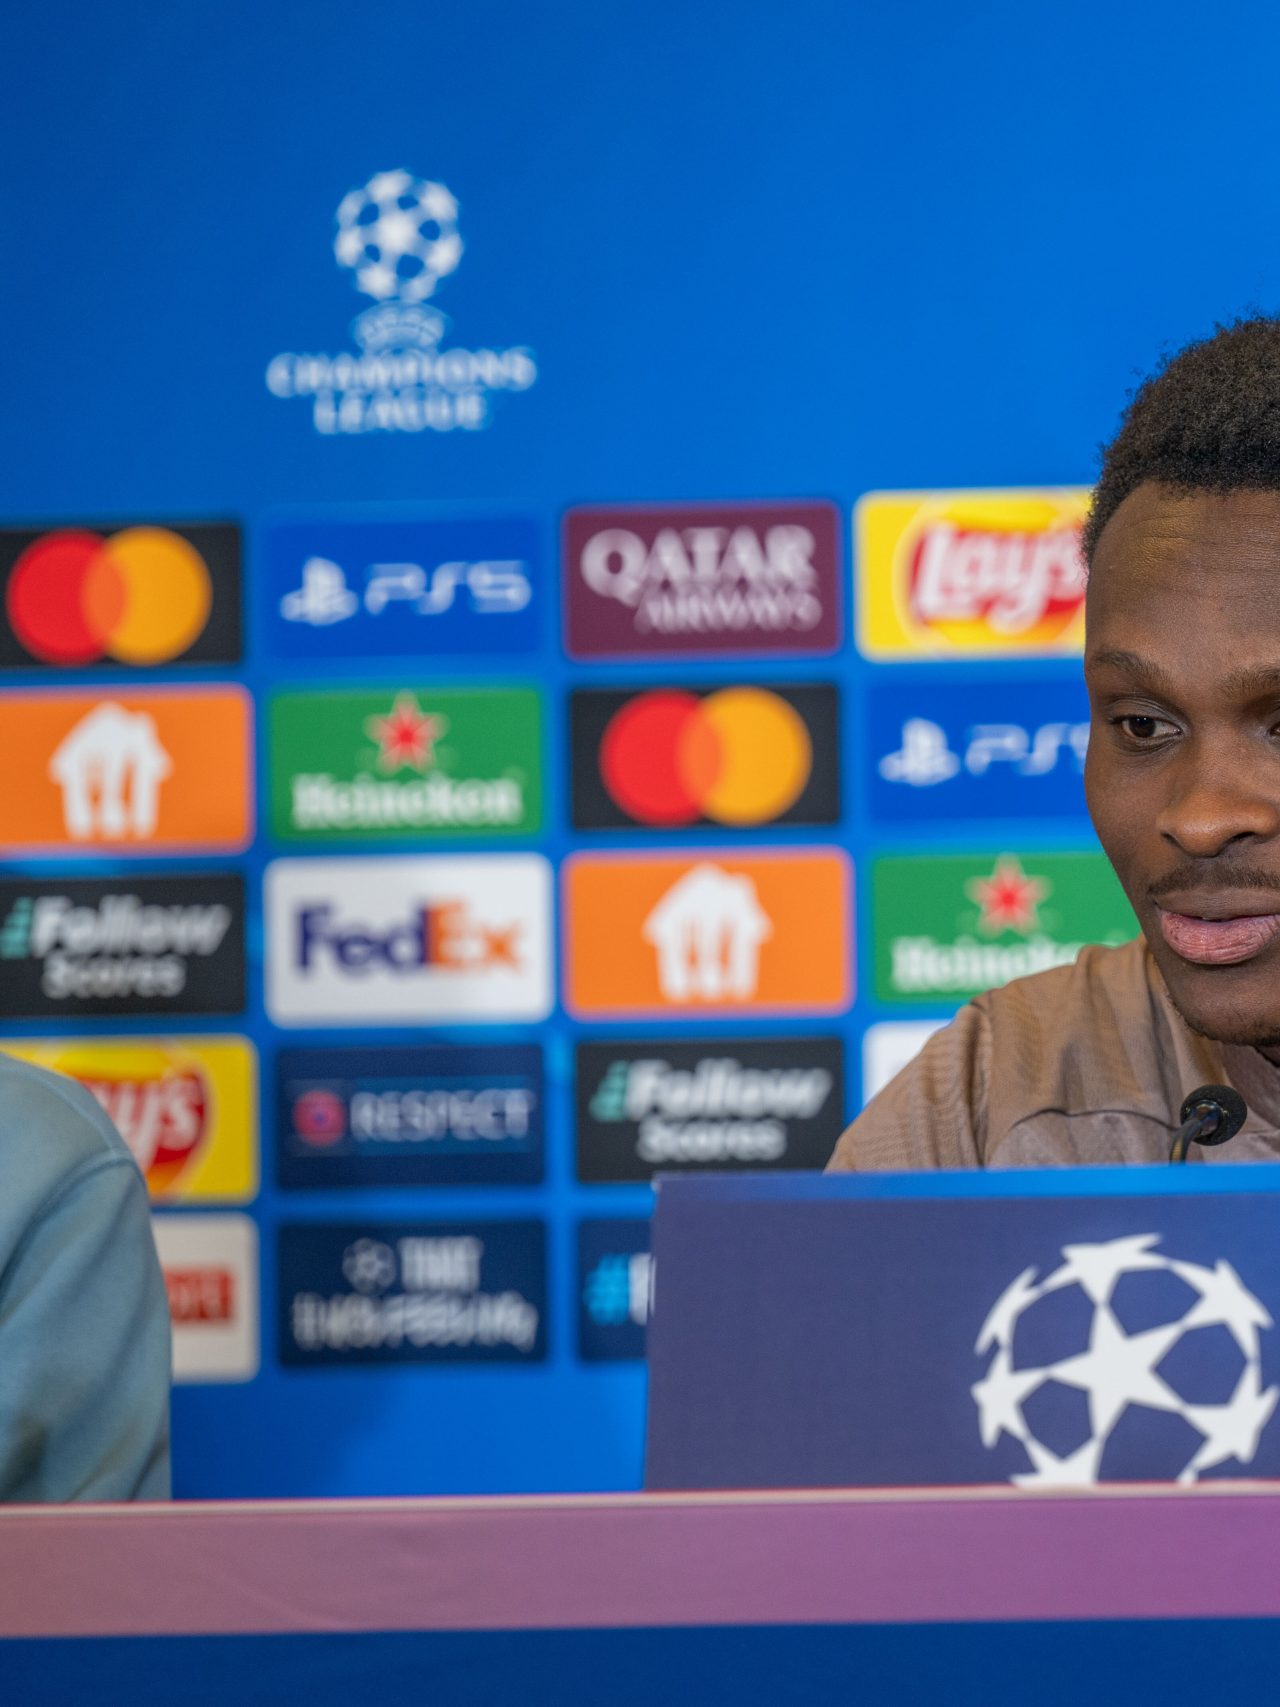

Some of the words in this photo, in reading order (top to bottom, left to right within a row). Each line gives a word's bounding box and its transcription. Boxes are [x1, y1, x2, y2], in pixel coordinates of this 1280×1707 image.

[267, 349, 536, 396] CHAMPIONS
[315, 389, 486, 433] LEAGUE
[367, 562, 530, 614] PS5
[583, 527, 813, 605] QATAR
[636, 587, 820, 632] AIRWAYS
[294, 774, 521, 828] Heineken
[34, 896, 230, 956] Follow
[298, 901, 522, 975] FedEx
[43, 954, 185, 998] Scores
[624, 1059, 831, 1118] Follow
[350, 1092, 532, 1140] RESPECT
[638, 1118, 785, 1161] Scores
